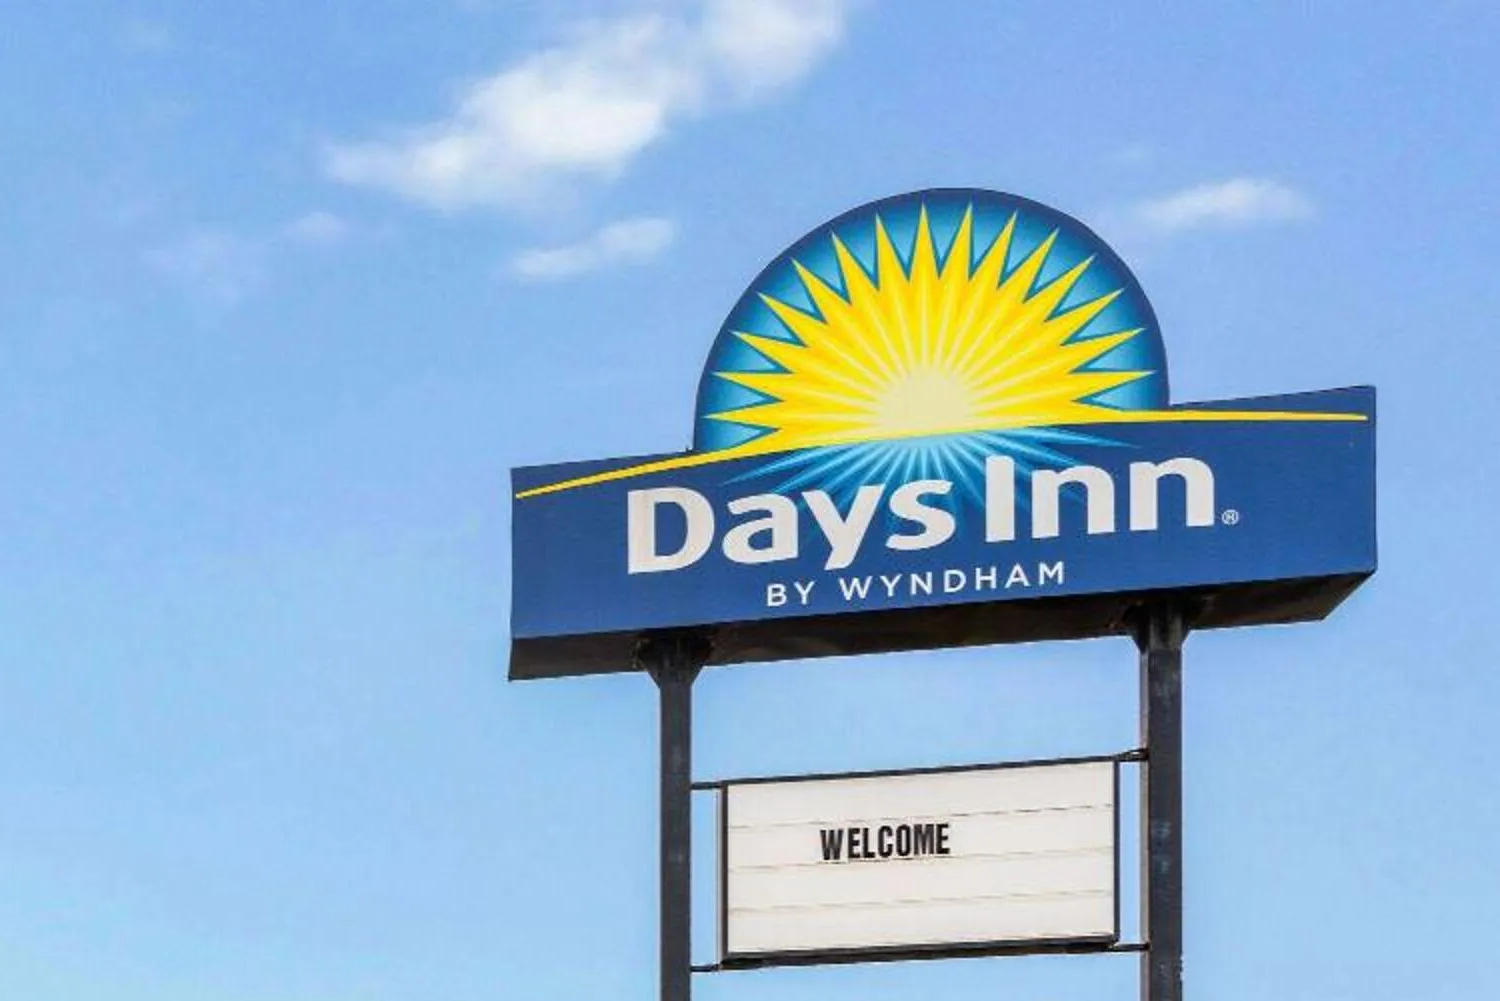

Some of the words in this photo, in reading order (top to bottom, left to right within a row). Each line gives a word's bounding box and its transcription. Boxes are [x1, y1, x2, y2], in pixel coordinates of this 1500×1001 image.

[627, 479, 956, 575] Days
[985, 455, 1215, 543] Inn
[766, 581, 816, 607] BY
[839, 561, 1065, 601] WYNDHAM
[819, 823, 951, 861] WELCOME
